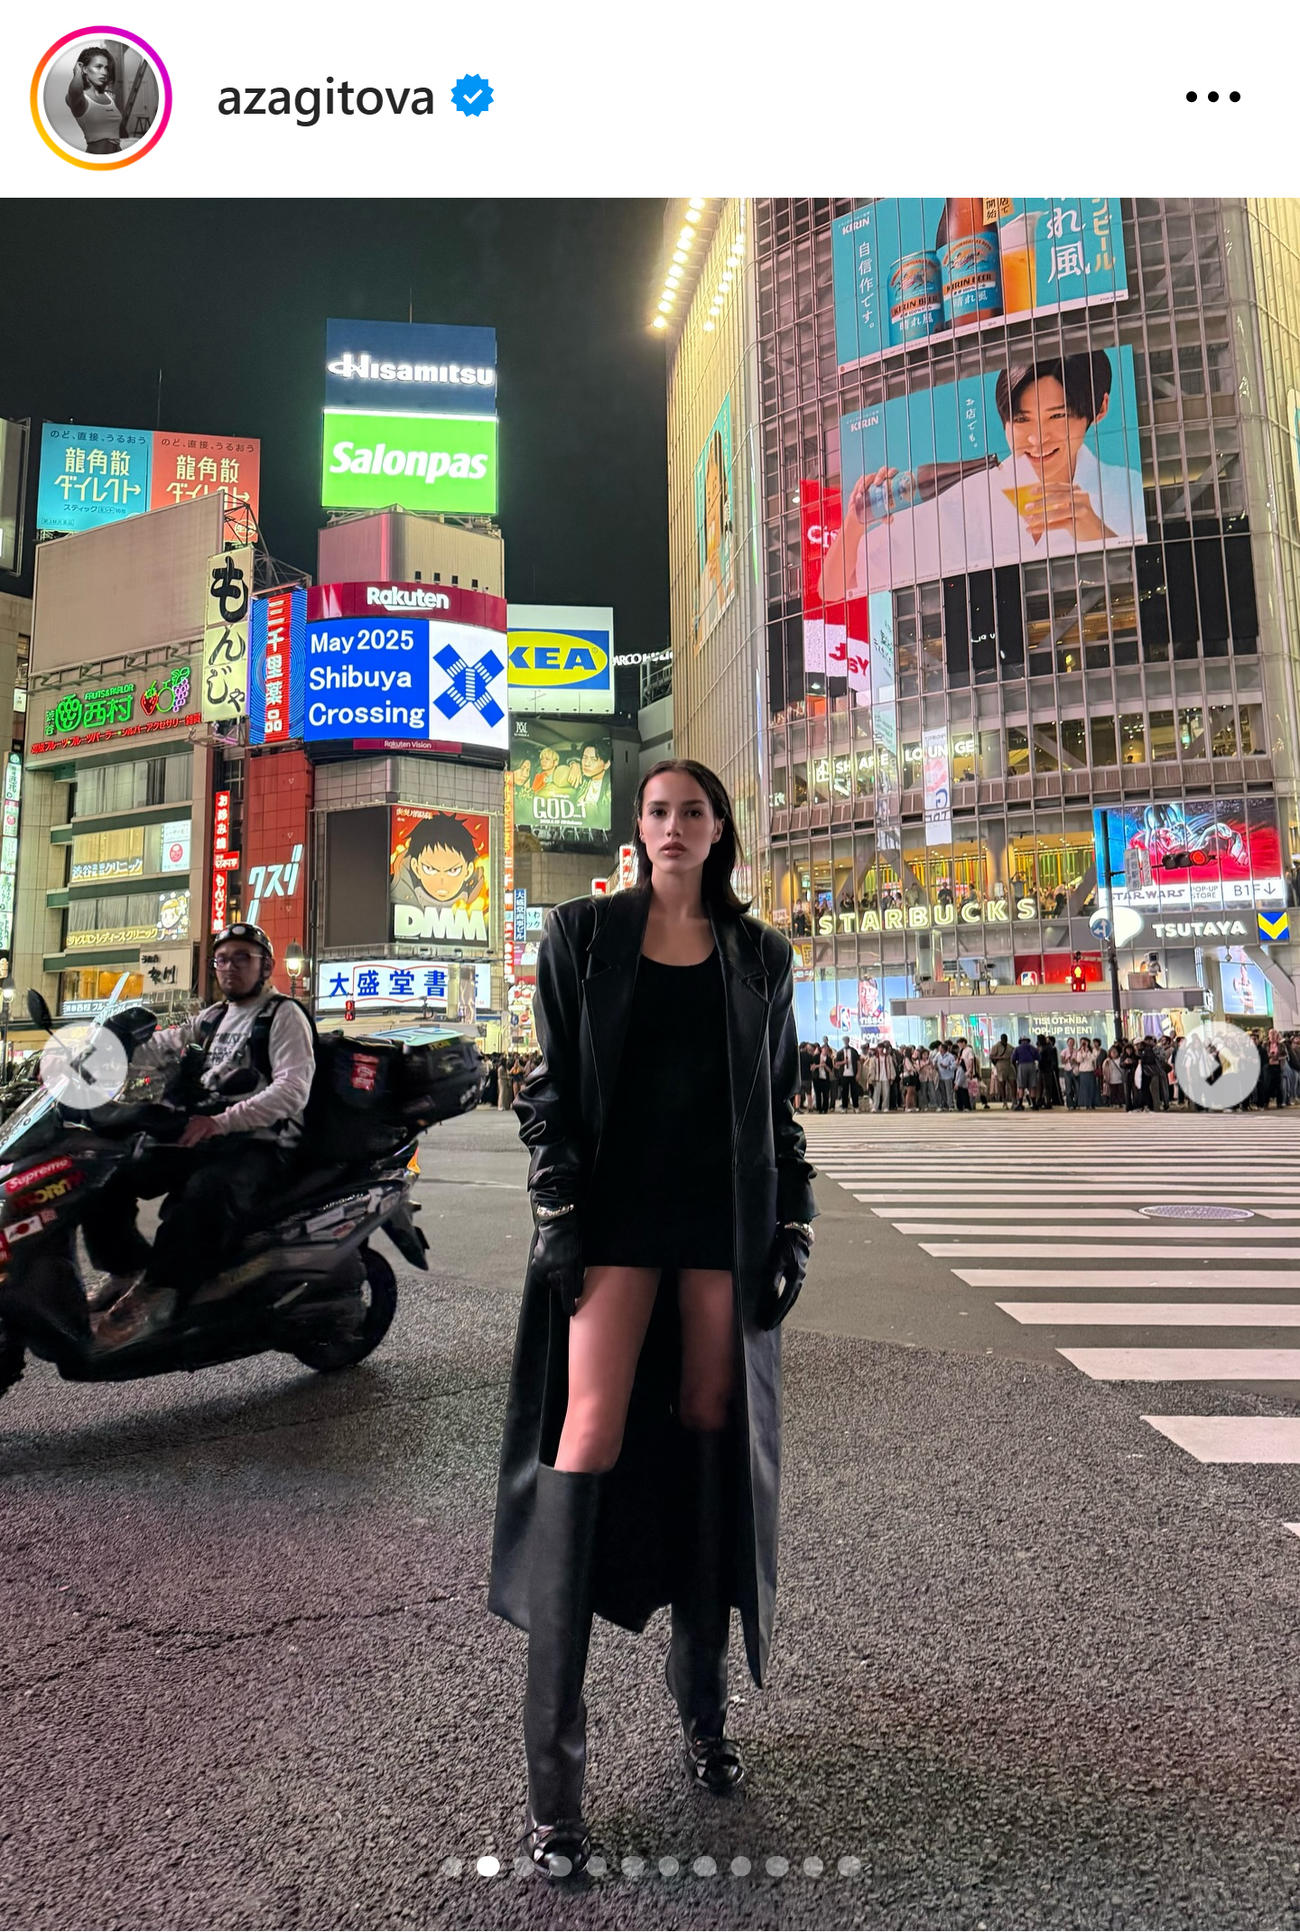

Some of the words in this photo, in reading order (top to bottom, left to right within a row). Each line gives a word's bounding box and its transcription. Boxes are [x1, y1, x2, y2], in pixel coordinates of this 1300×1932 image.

[842, 216, 870, 235] KIRIN
[1046, 198, 1091, 284] れ風
[859, 242, 875, 329] 自信作です。
[893, 300, 917, 315] KIRIN
[328, 353, 494, 386] Hisamitsu
[850, 415, 880, 433] KIRIN
[65, 447, 131, 476] 龍角散
[176, 454, 240, 484] 龍角散
[329, 441, 489, 484] Salonpas
[54, 475, 142, 504] ダイレクト
[367, 586, 450, 611] Rakuten
[206, 556, 249, 713] もんじゃ
[311, 632, 355, 654] May
[357, 629, 414, 651] 2025
[264, 599, 286, 733] 三千里薬品
[508, 646, 598, 670] KEA
[309, 664, 412, 691] Shibuya
[83, 694, 134, 729] 西村
[308, 699, 425, 729] Crossing
[384, 740, 411, 749] Rakuten
[412, 740, 432, 749] Vision
[905, 740, 975, 762] LOUNGE
[246, 844, 304, 926] クスリ
[394, 904, 488, 941] DMM
[819, 898, 1036, 935] STARBUCKS
[1152, 920, 1248, 938] TSUTAYA
[10, 1159, 69, 1190] Supreme
